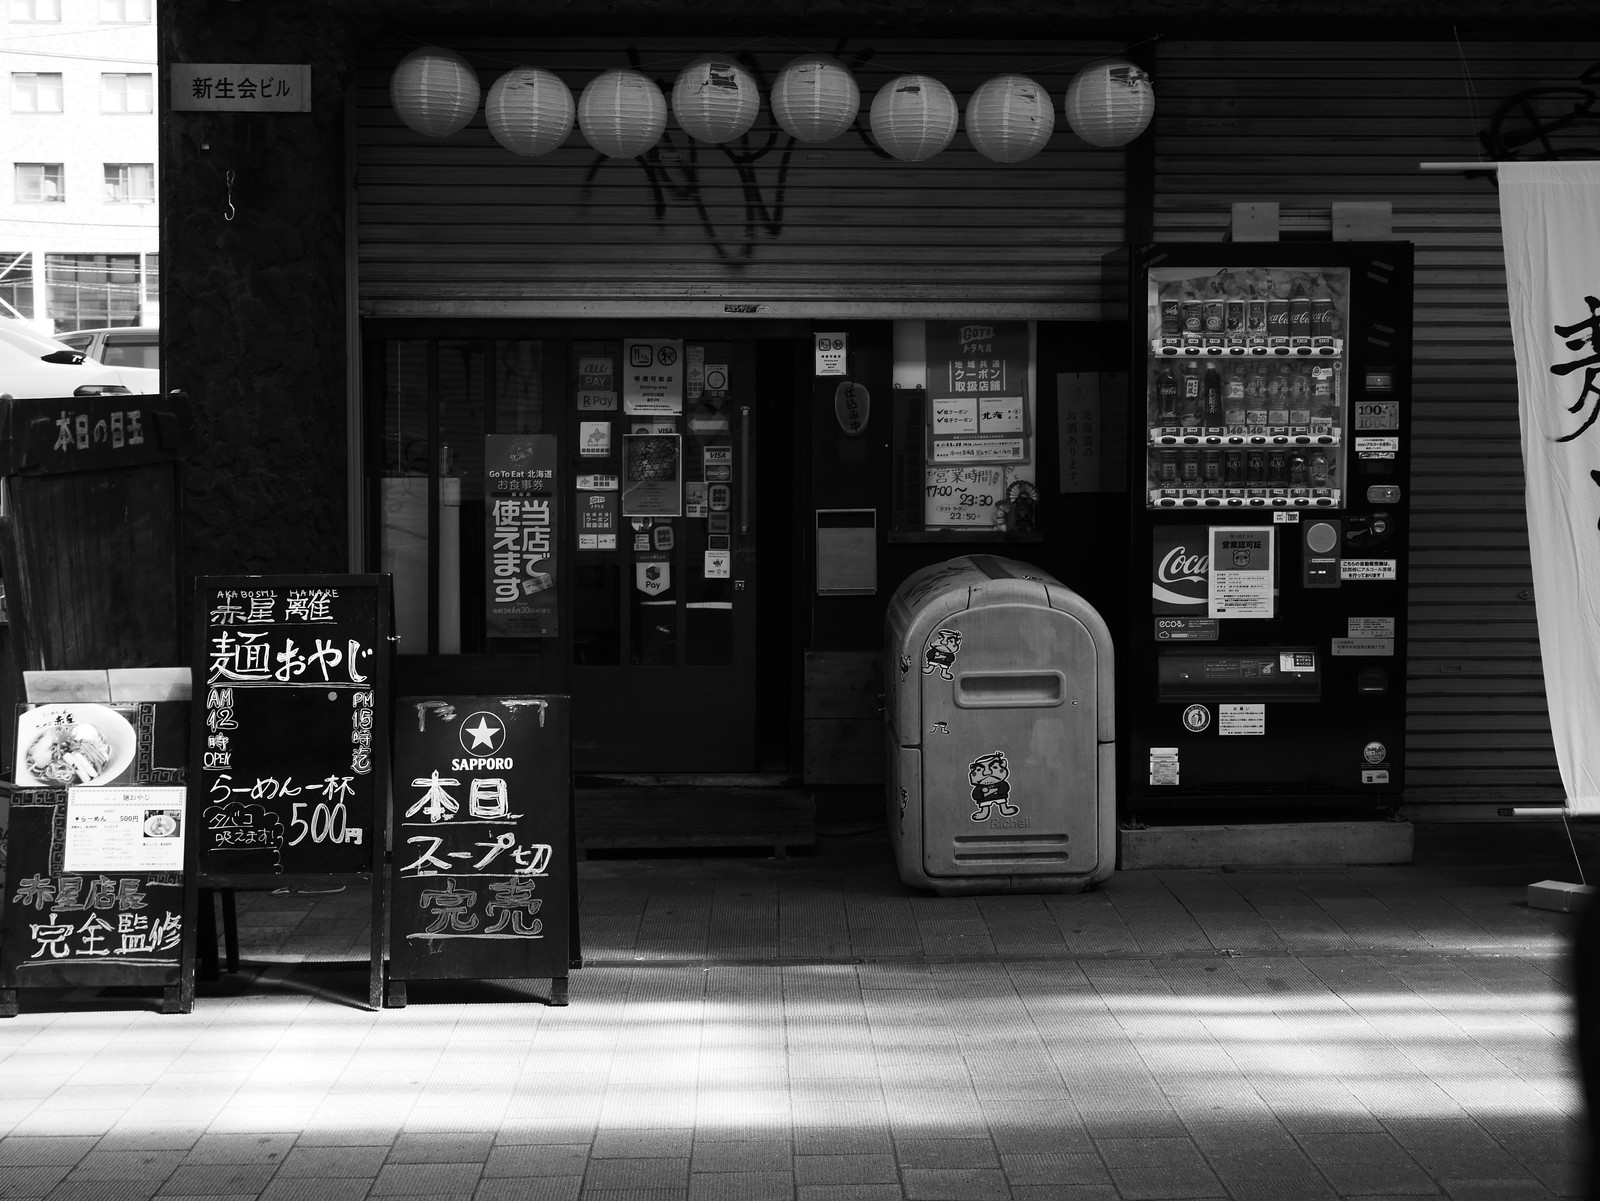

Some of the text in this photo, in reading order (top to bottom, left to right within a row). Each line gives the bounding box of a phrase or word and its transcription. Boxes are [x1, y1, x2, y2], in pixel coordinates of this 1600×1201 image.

[192, 76, 292, 99] 新生会ビル
[963, 343, 993, 354] トラベル
[584, 376, 607, 388] PAY
[954, 369, 1001, 381] クーポン
[954, 381, 1001, 393] 取扱店舗
[592, 396, 614, 408] Pay
[511, 470, 525, 478] Eat
[527, 470, 553, 479] 北海道
[936, 467, 992, 486] 営業時間
[497, 479, 544, 491] お食事券
[959, 493, 993, 507] 23:30
[949, 512, 977, 521] 22:50
[521, 499, 551, 579] 当店で
[492, 499, 521, 603] 使えます
[645, 580, 661, 590] Pay
[209, 597, 276, 625] 赤星
[206, 687, 235, 708] AM
[351, 690, 375, 708] PM
[206, 707, 239, 734] 12
[207, 732, 230, 750] 時
[203, 752, 231, 767] OPEN
[451, 757, 514, 772] SAPPORO
[405, 769, 509, 822] 本日
[81, 815, 140, 823] らーめん 500円
[287, 802, 363, 847] 500円
[13, 873, 149, 912] 赤星店長
[419, 876, 543, 936] 完売
[29, 912, 182, 958] 完全監修
